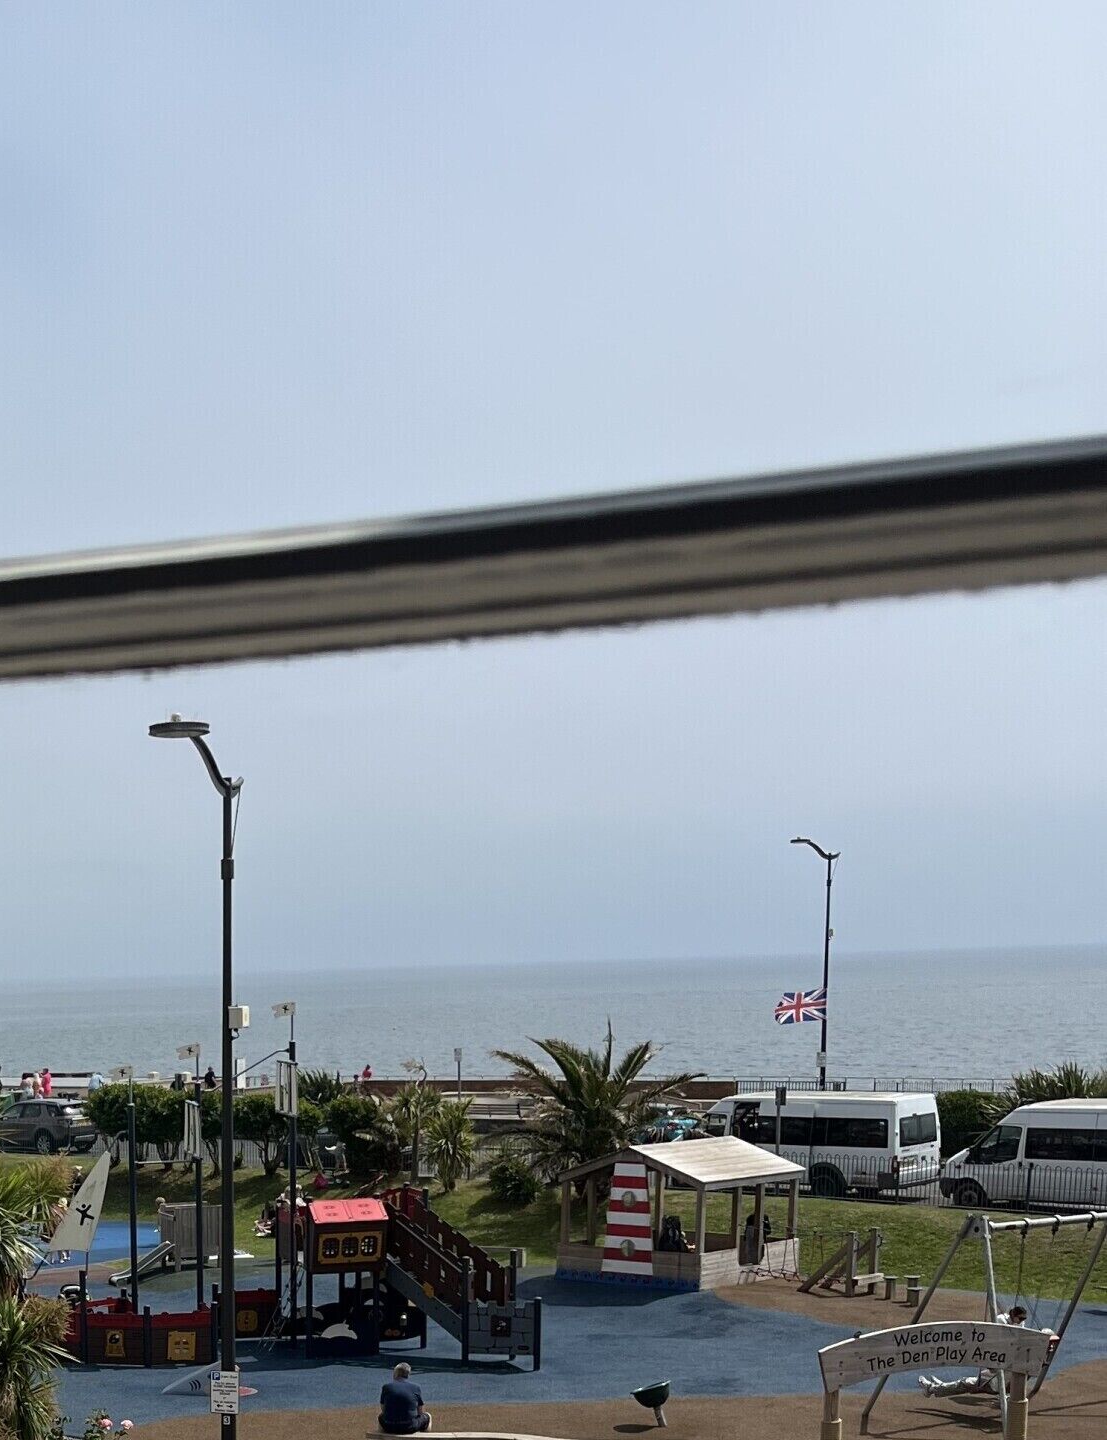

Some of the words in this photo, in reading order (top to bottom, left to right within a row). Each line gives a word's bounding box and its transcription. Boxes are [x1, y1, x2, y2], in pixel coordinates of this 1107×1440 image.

[894, 1329, 963, 1347] Welcome
[972, 1328, 986, 1343] to
[866, 1357, 895, 1372] The
[902, 1350, 929, 1365] Den
[935, 1346, 967, 1363] Play
[972, 1346, 1006, 1363] Area
